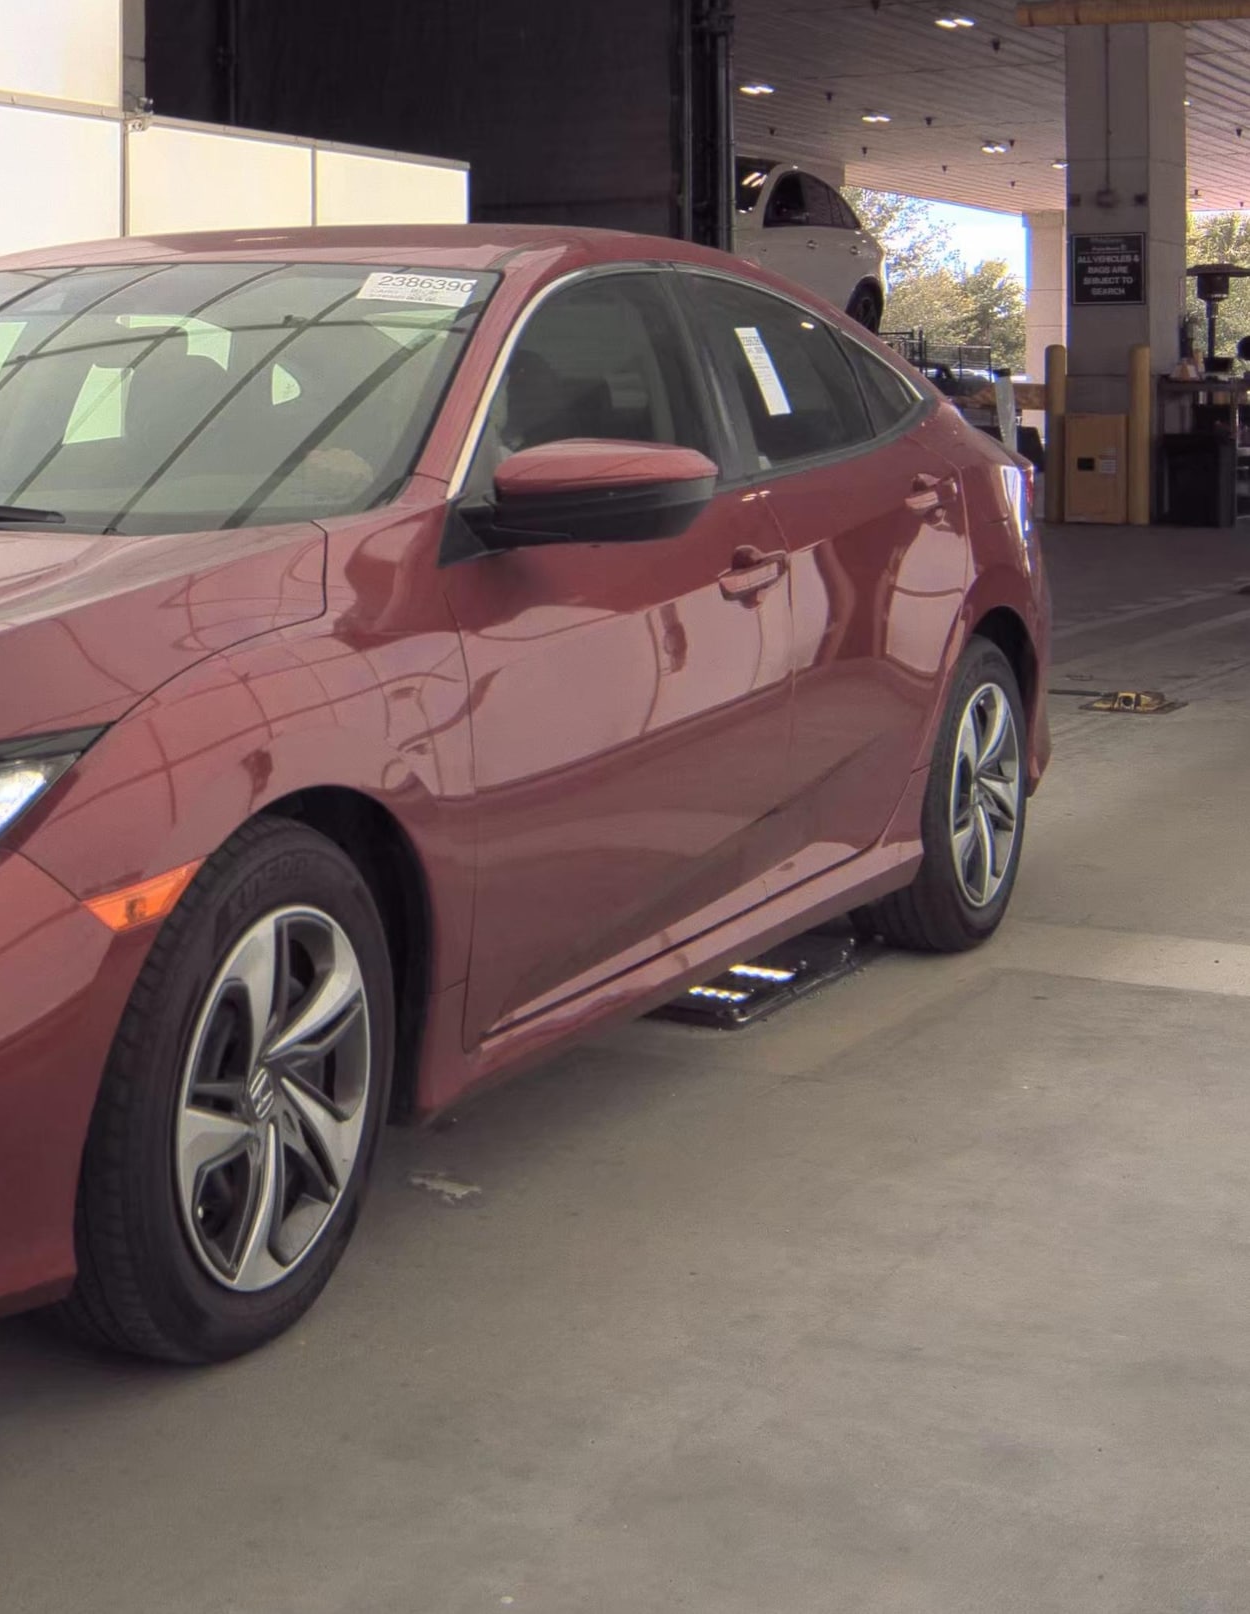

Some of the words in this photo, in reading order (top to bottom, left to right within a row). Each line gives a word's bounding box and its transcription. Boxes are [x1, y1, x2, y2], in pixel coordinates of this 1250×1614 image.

[1093, 254, 1132, 263] VEHICLES
[1087, 266, 1111, 274] BAGS
[1112, 266, 1129, 274] ARE
[378, 275, 474, 293] 2386390
[1083, 277, 1120, 285] SUBJECT
[1122, 276, 1134, 284] TO
[1091, 287, 1126, 296] SEARCH
